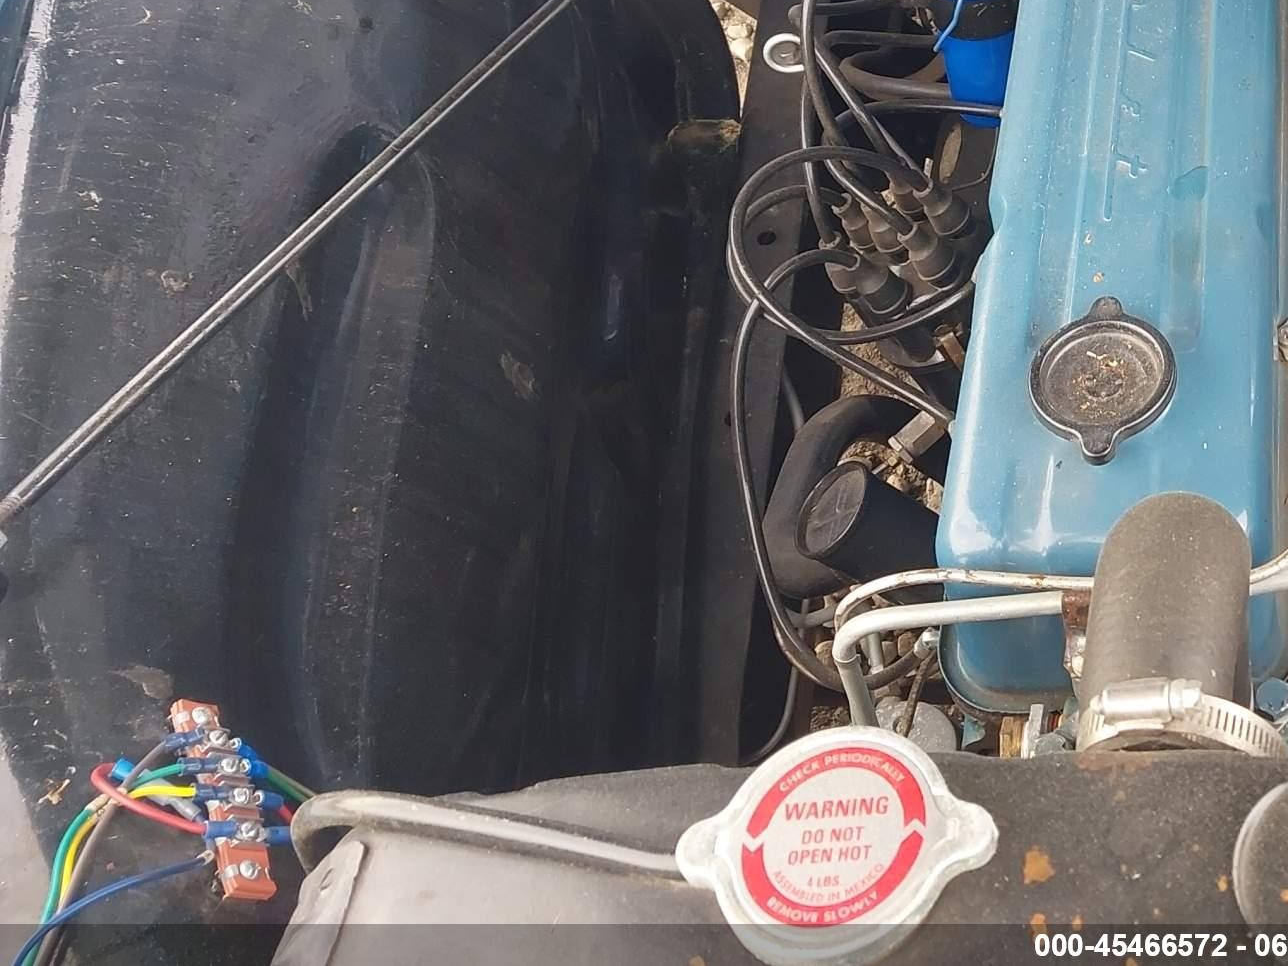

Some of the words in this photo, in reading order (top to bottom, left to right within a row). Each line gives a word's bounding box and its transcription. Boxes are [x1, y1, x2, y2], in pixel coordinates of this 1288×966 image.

[779, 759, 820, 792] CHECK
[824, 752, 906, 783] PERIODICALLY
[784, 796, 889, 822] WARNING
[801, 829, 824, 846] DO
[830, 826, 865, 843] NOT
[787, 848, 832, 866] OPEN
[838, 845, 872, 861] HOT
[773, 870, 825, 904] ASSEMBLED
[827, 891, 841, 903] IN
[844, 863, 886, 900] MEXICO
[766, 896, 819, 923] REMOVE
[823, 890, 880, 923] SLOWLY
